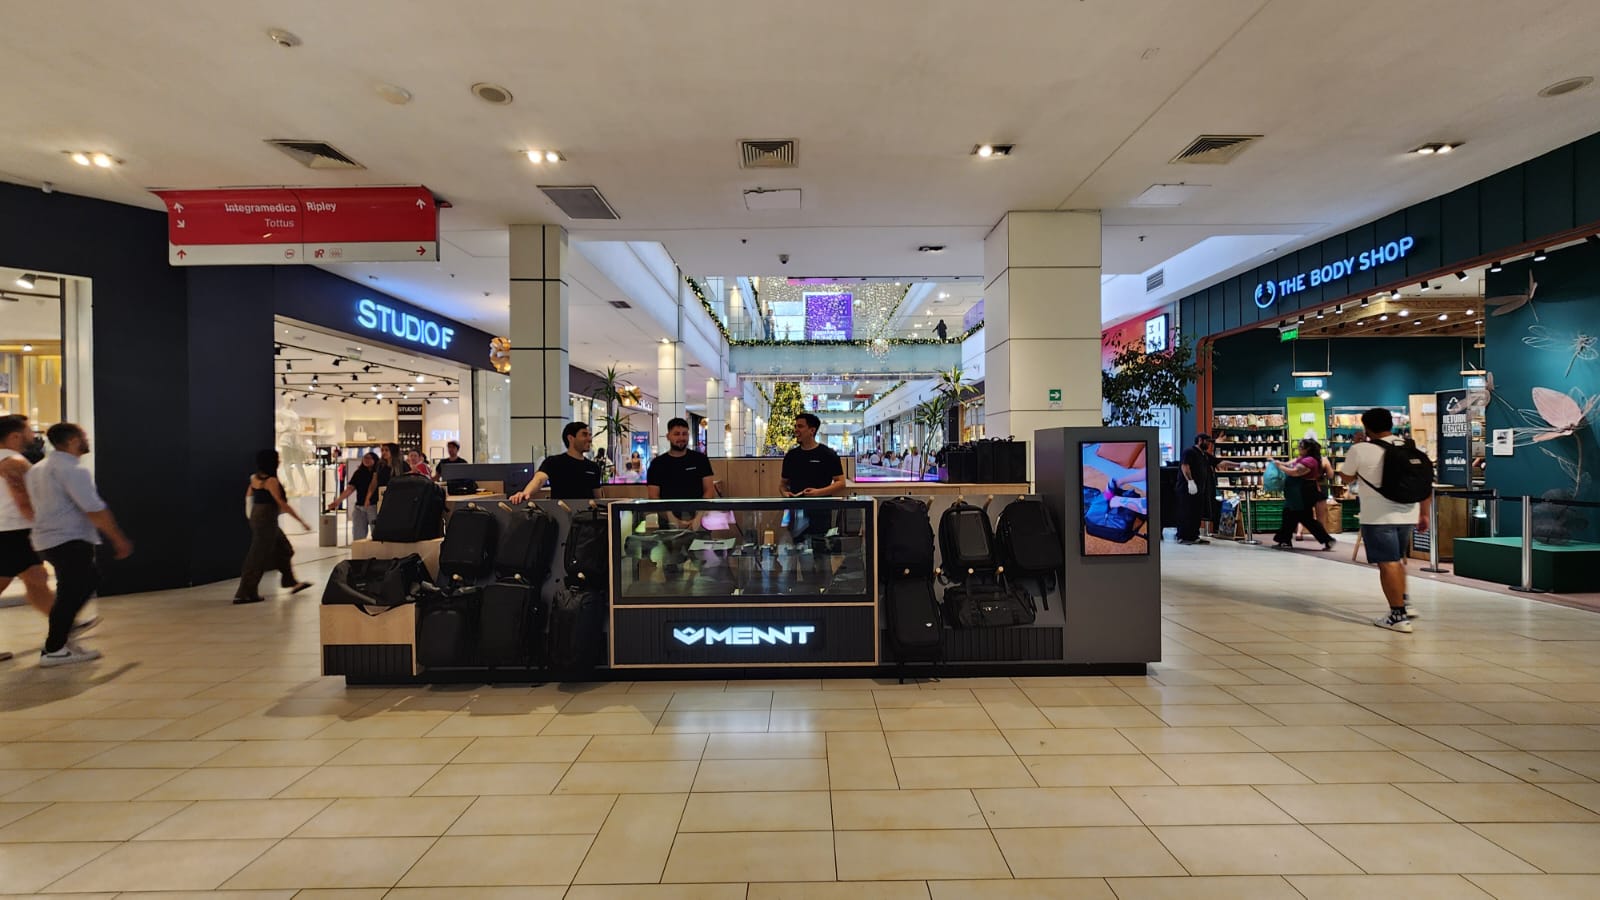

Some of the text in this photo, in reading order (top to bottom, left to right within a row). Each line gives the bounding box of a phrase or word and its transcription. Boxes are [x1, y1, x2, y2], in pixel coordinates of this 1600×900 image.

[306, 201, 337, 213] Ripley
[264, 218, 295, 228] Tottus
[1278, 236, 1415, 297] THE BODY SHOP
[358, 299, 454, 350] STUDIO F
[1443, 414, 1466, 424] RETURN
[1442, 424, 1467, 433] RECYCLE
[705, 626, 815, 645] MENNT
